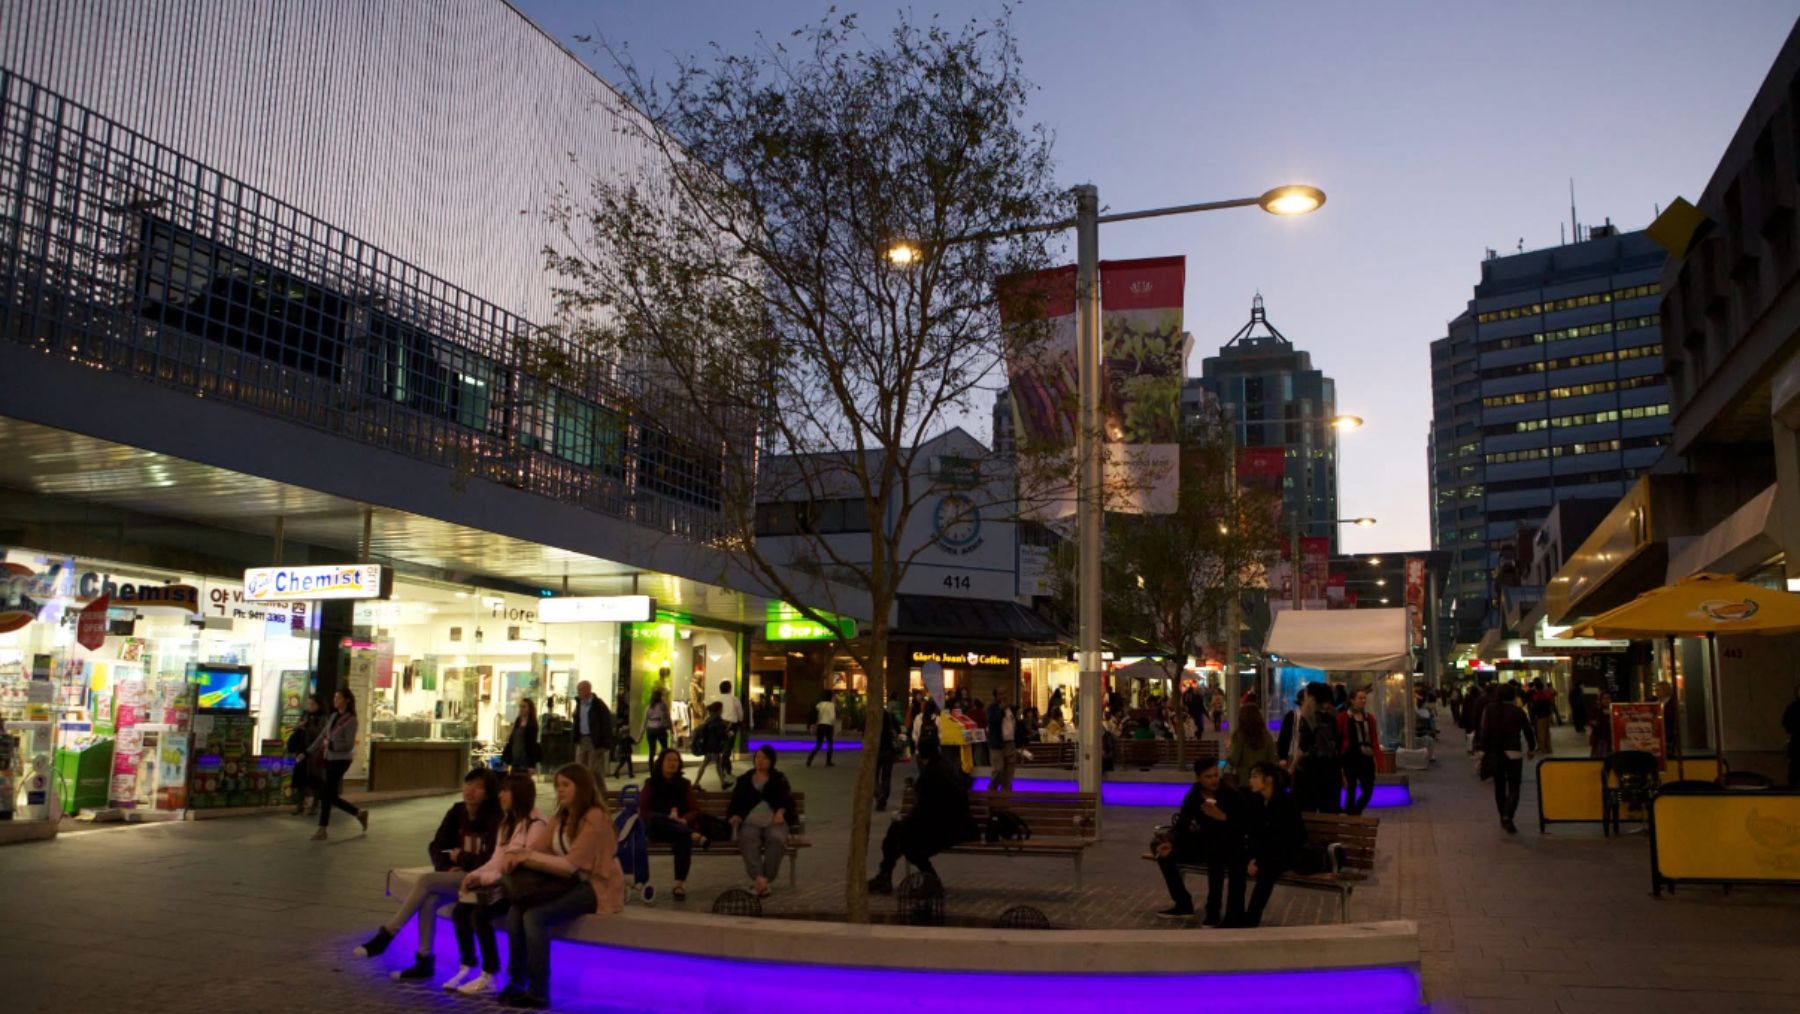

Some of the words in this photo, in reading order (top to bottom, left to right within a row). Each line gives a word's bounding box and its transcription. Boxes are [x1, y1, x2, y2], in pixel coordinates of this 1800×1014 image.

[80, 572, 198, 604] Chemist
[275, 567, 362, 592] Chemist
[943, 575, 970, 589] 414
[210, 588, 230, 616] 약
[913, 651, 941, 662] Gloria
[942, 653, 966, 663] Jean's
[979, 654, 1010, 664] Coffees
